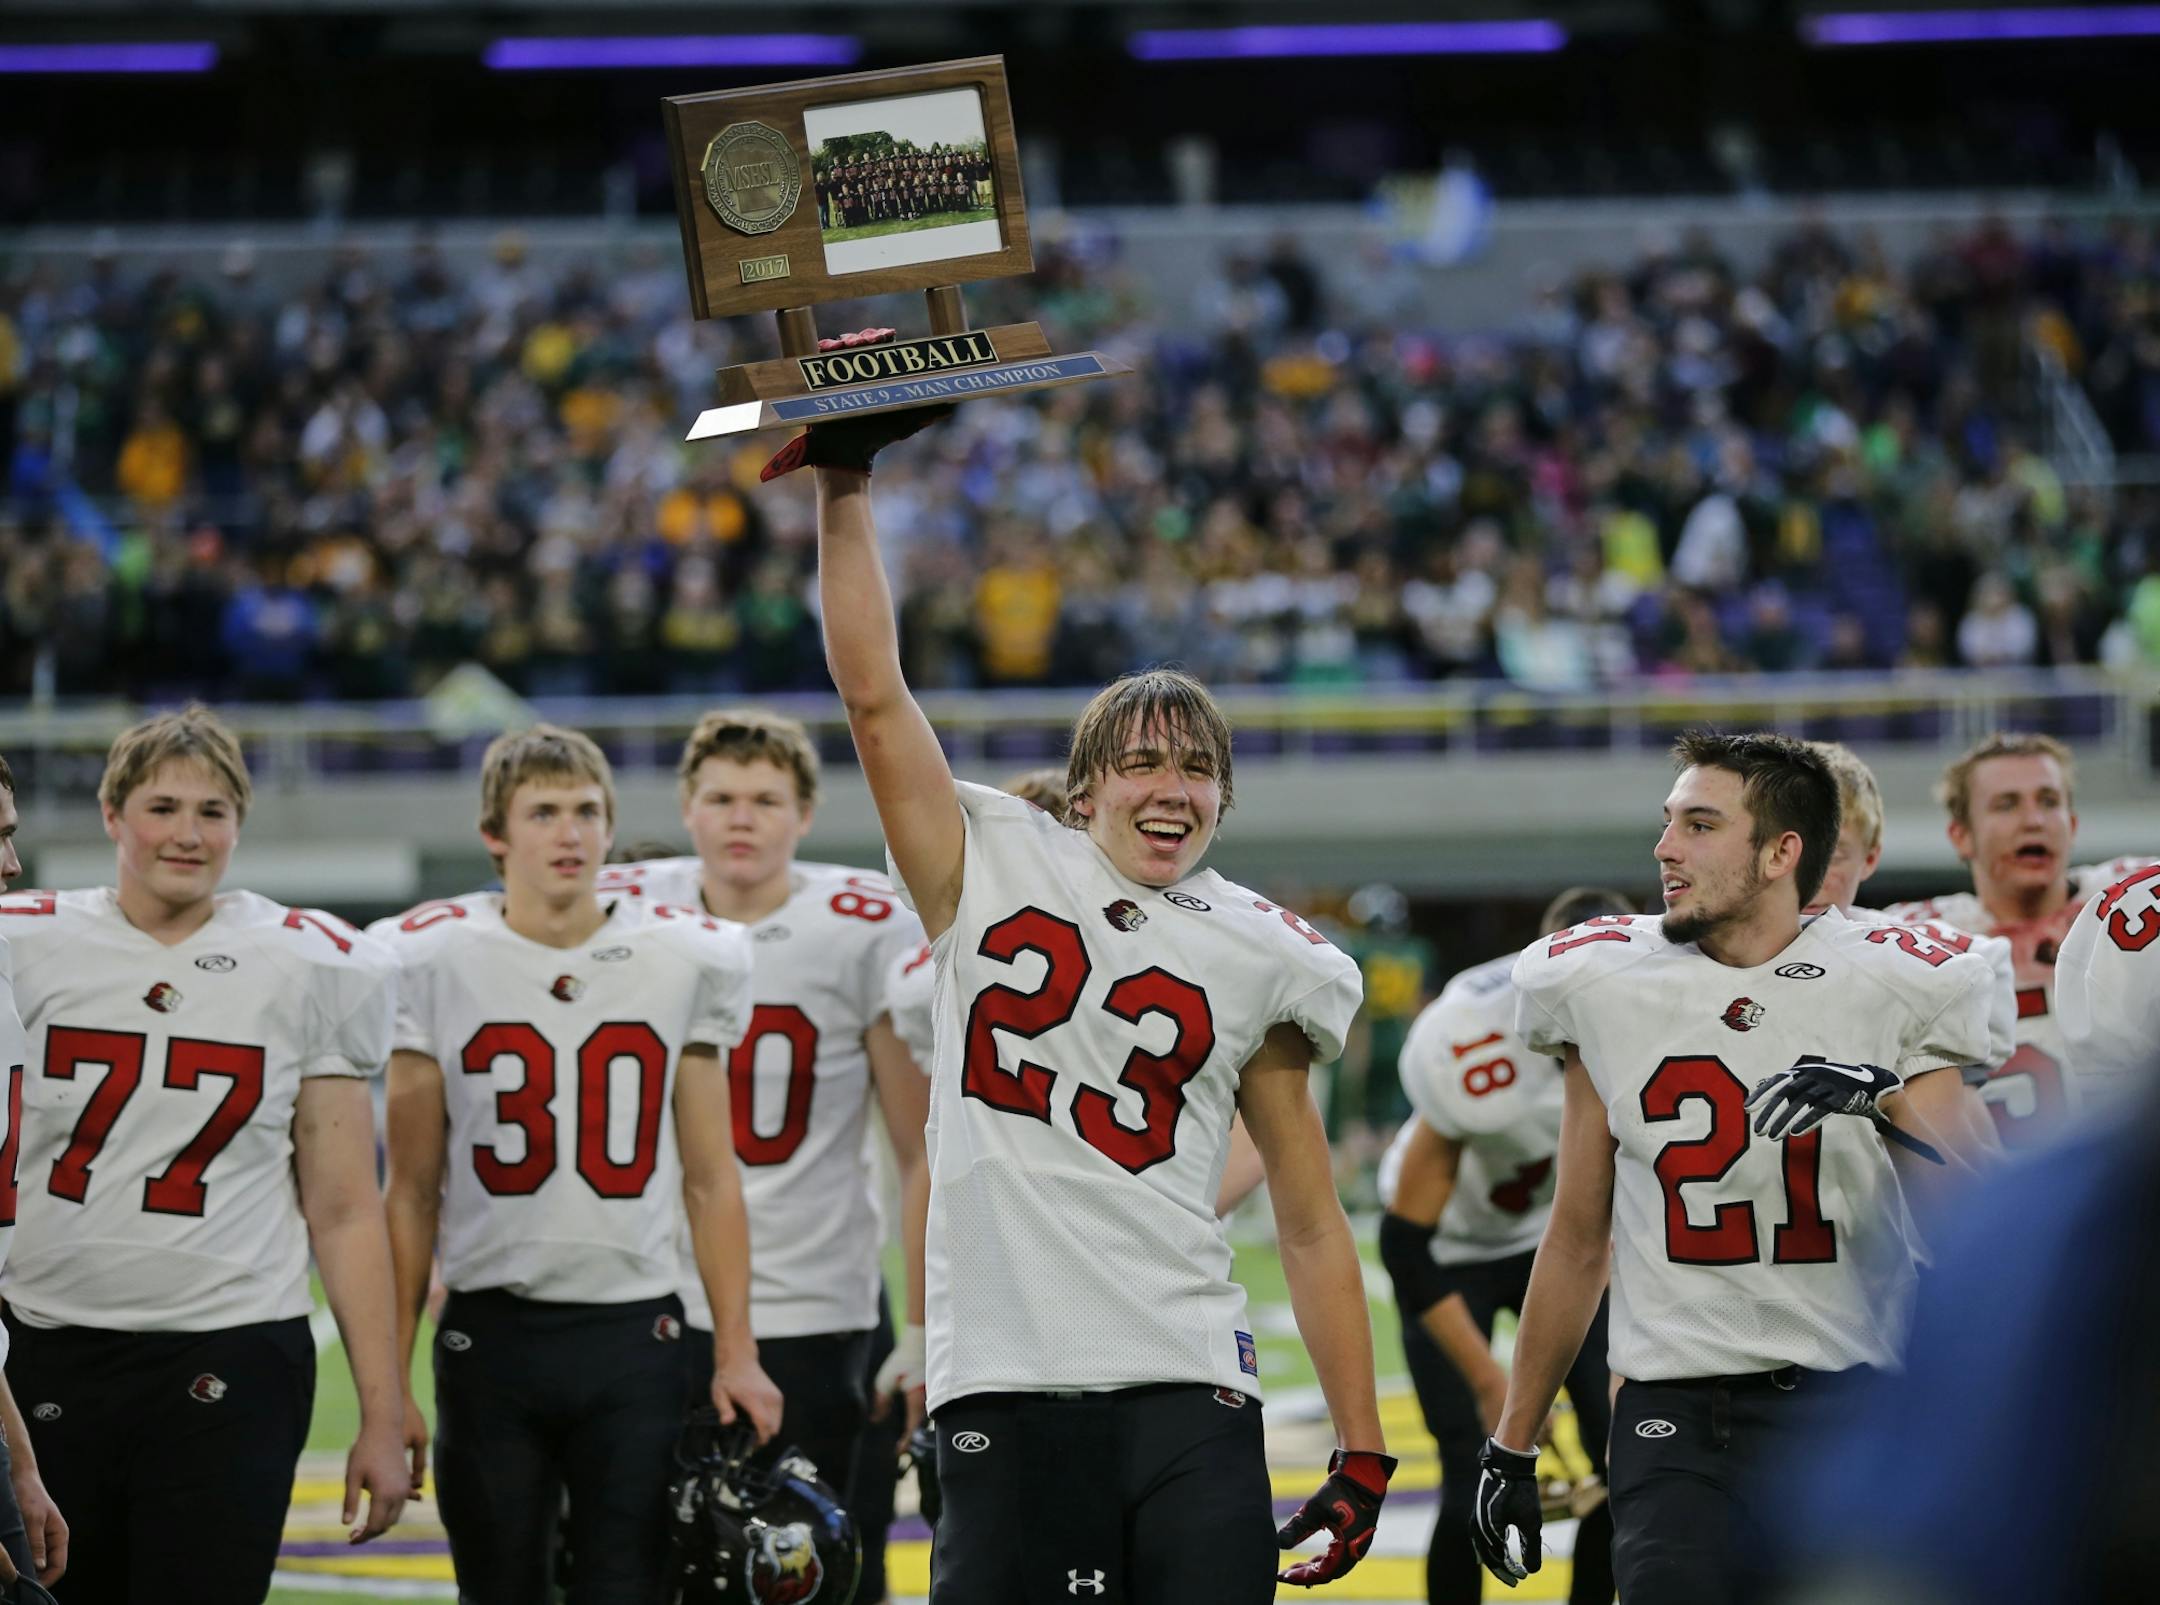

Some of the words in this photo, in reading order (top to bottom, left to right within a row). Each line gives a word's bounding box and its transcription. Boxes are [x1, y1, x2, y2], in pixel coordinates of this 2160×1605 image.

[726, 162, 780, 192] MSHSL
[744, 259, 785, 279] 2017
[803, 336, 994, 387] FOOTBALL
[814, 390, 878, 412] STATE
[878, 389, 891, 402] 9
[904, 380, 952, 399] MAN
[953, 363, 1062, 390] CHAMPION
[961, 905, 1216, 1176] 23
[1452, 1031, 1516, 1098] 18
[43, 1025, 265, 1217] 77
[461, 1021, 667, 1199] 30
[1639, 1055, 1838, 1265] 21
